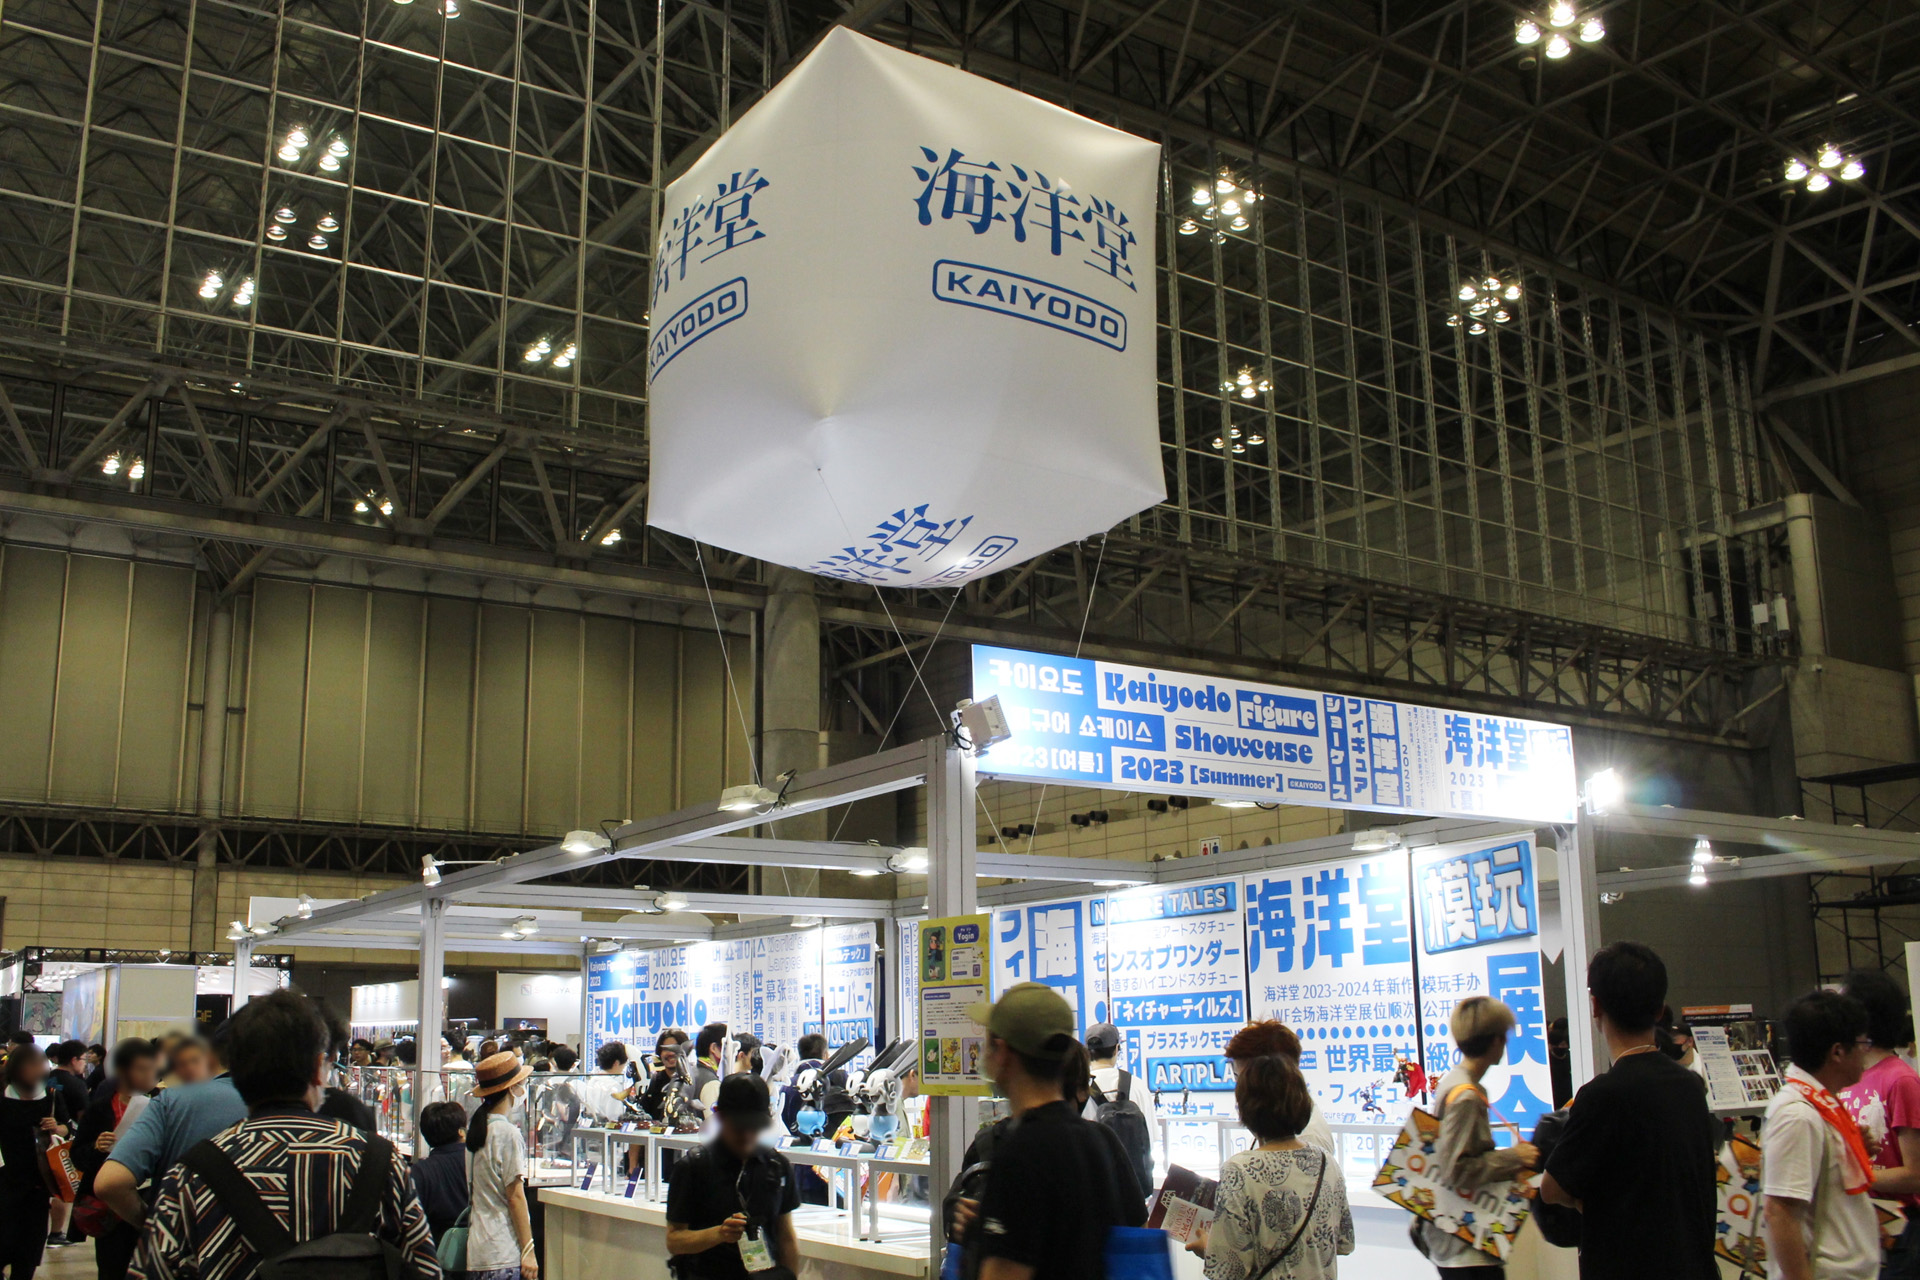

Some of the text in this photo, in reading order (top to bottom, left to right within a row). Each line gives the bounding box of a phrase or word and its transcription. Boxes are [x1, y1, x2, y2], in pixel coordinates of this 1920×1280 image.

[911, 146, 1138, 293] 海洋堂
[947, 270, 1119, 340] KAIYODO
[1104, 672, 1316, 730] Kaiyodo Figure
[1079, 714, 1153, 743] 쇼케이스
[1175, 724, 1313, 764] Showcase
[1326, 697, 1348, 800] ショーケース
[1347, 698, 1369, 793] フィギュア
[1444, 714, 1528, 771] 海洋堂
[1121, 755, 1323, 793] 2023 [Summer] ©KAIYODO
[1368, 703, 1401, 805] 海洋堂
[1450, 771, 1484, 787] 2023
[1168, 887, 1226, 914] TALES
[1424, 846, 1528, 948] 模玩
[957, 932, 975, 942] Yogin
[1247, 863, 1410, 974] 海洋堂
[1093, 939, 1239, 973] センスオブワンダー
[605, 990, 707, 1034] Kaiyodo
[1113, 995, 1240, 1021] 「ネイチャーテイルズ」
[1264, 984, 1300, 1003] 海洋堂
[1302, 981, 1370, 1000] 2023-2024
[1147, 1030, 1241, 1050] プラスチックモデ
